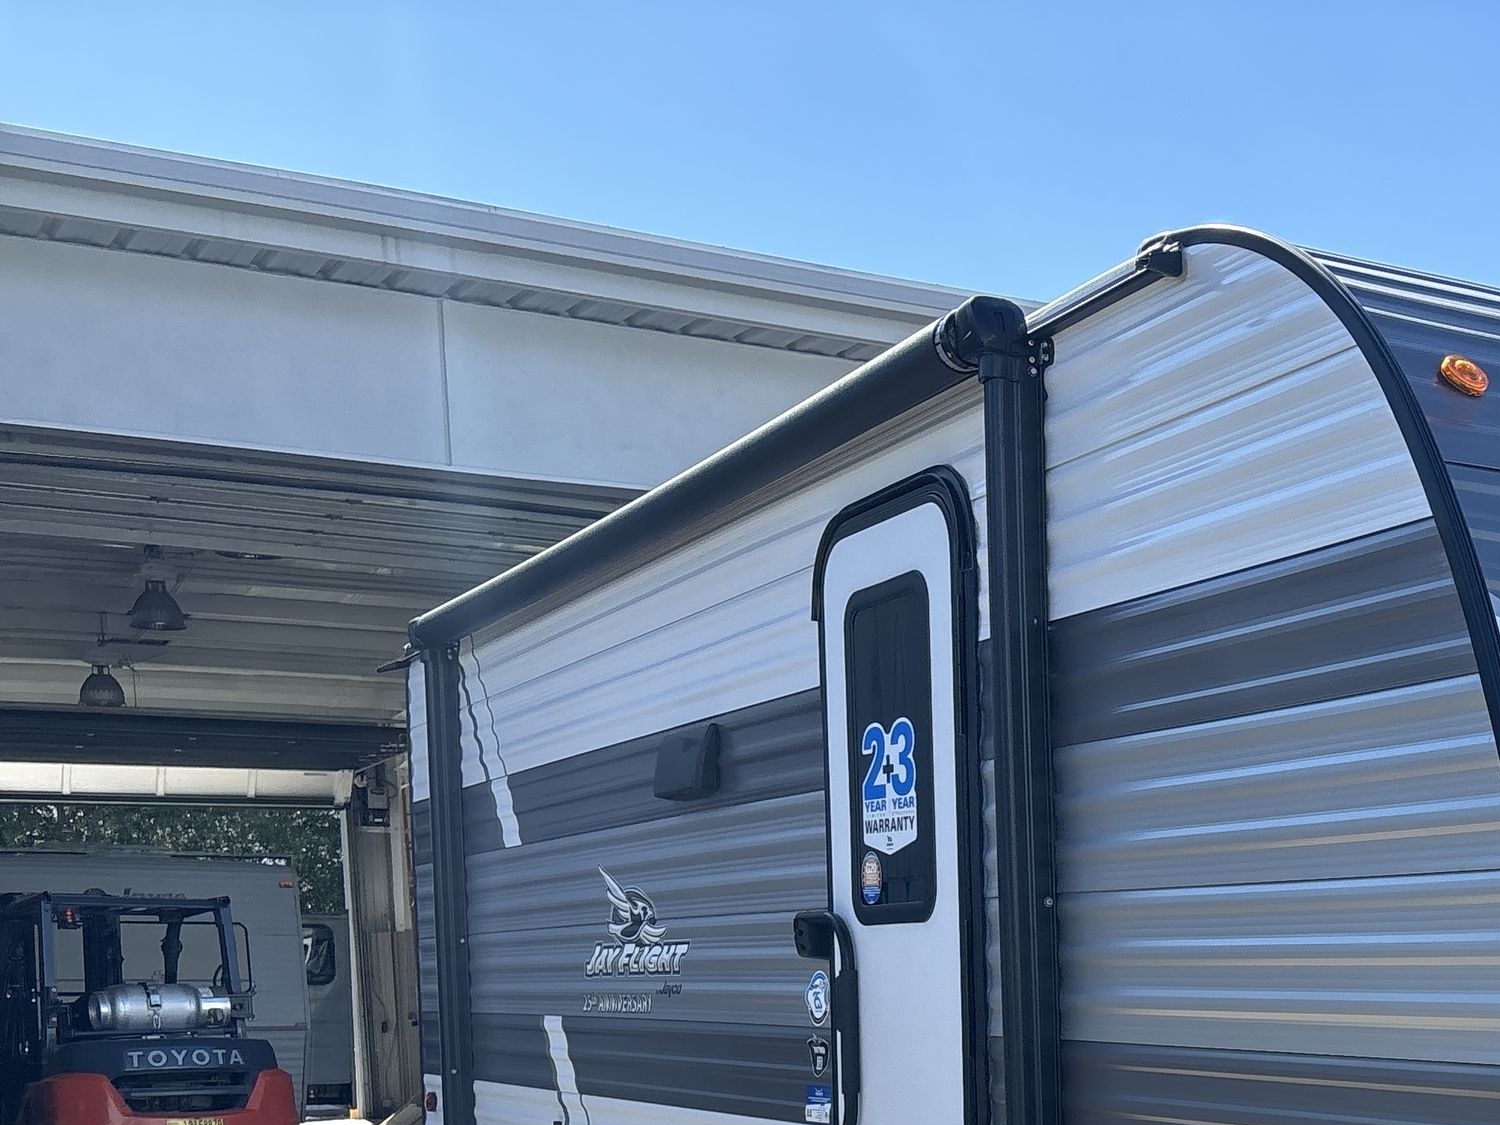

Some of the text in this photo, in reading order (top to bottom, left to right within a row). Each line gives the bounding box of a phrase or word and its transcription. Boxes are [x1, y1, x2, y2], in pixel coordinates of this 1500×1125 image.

[865, 796, 915, 812] YEAR YEAR
[865, 815, 915, 834] WARRANTY
[585, 939, 691, 978] JAY FLIGHT
[127, 1049, 244, 1068] TOYOTA
